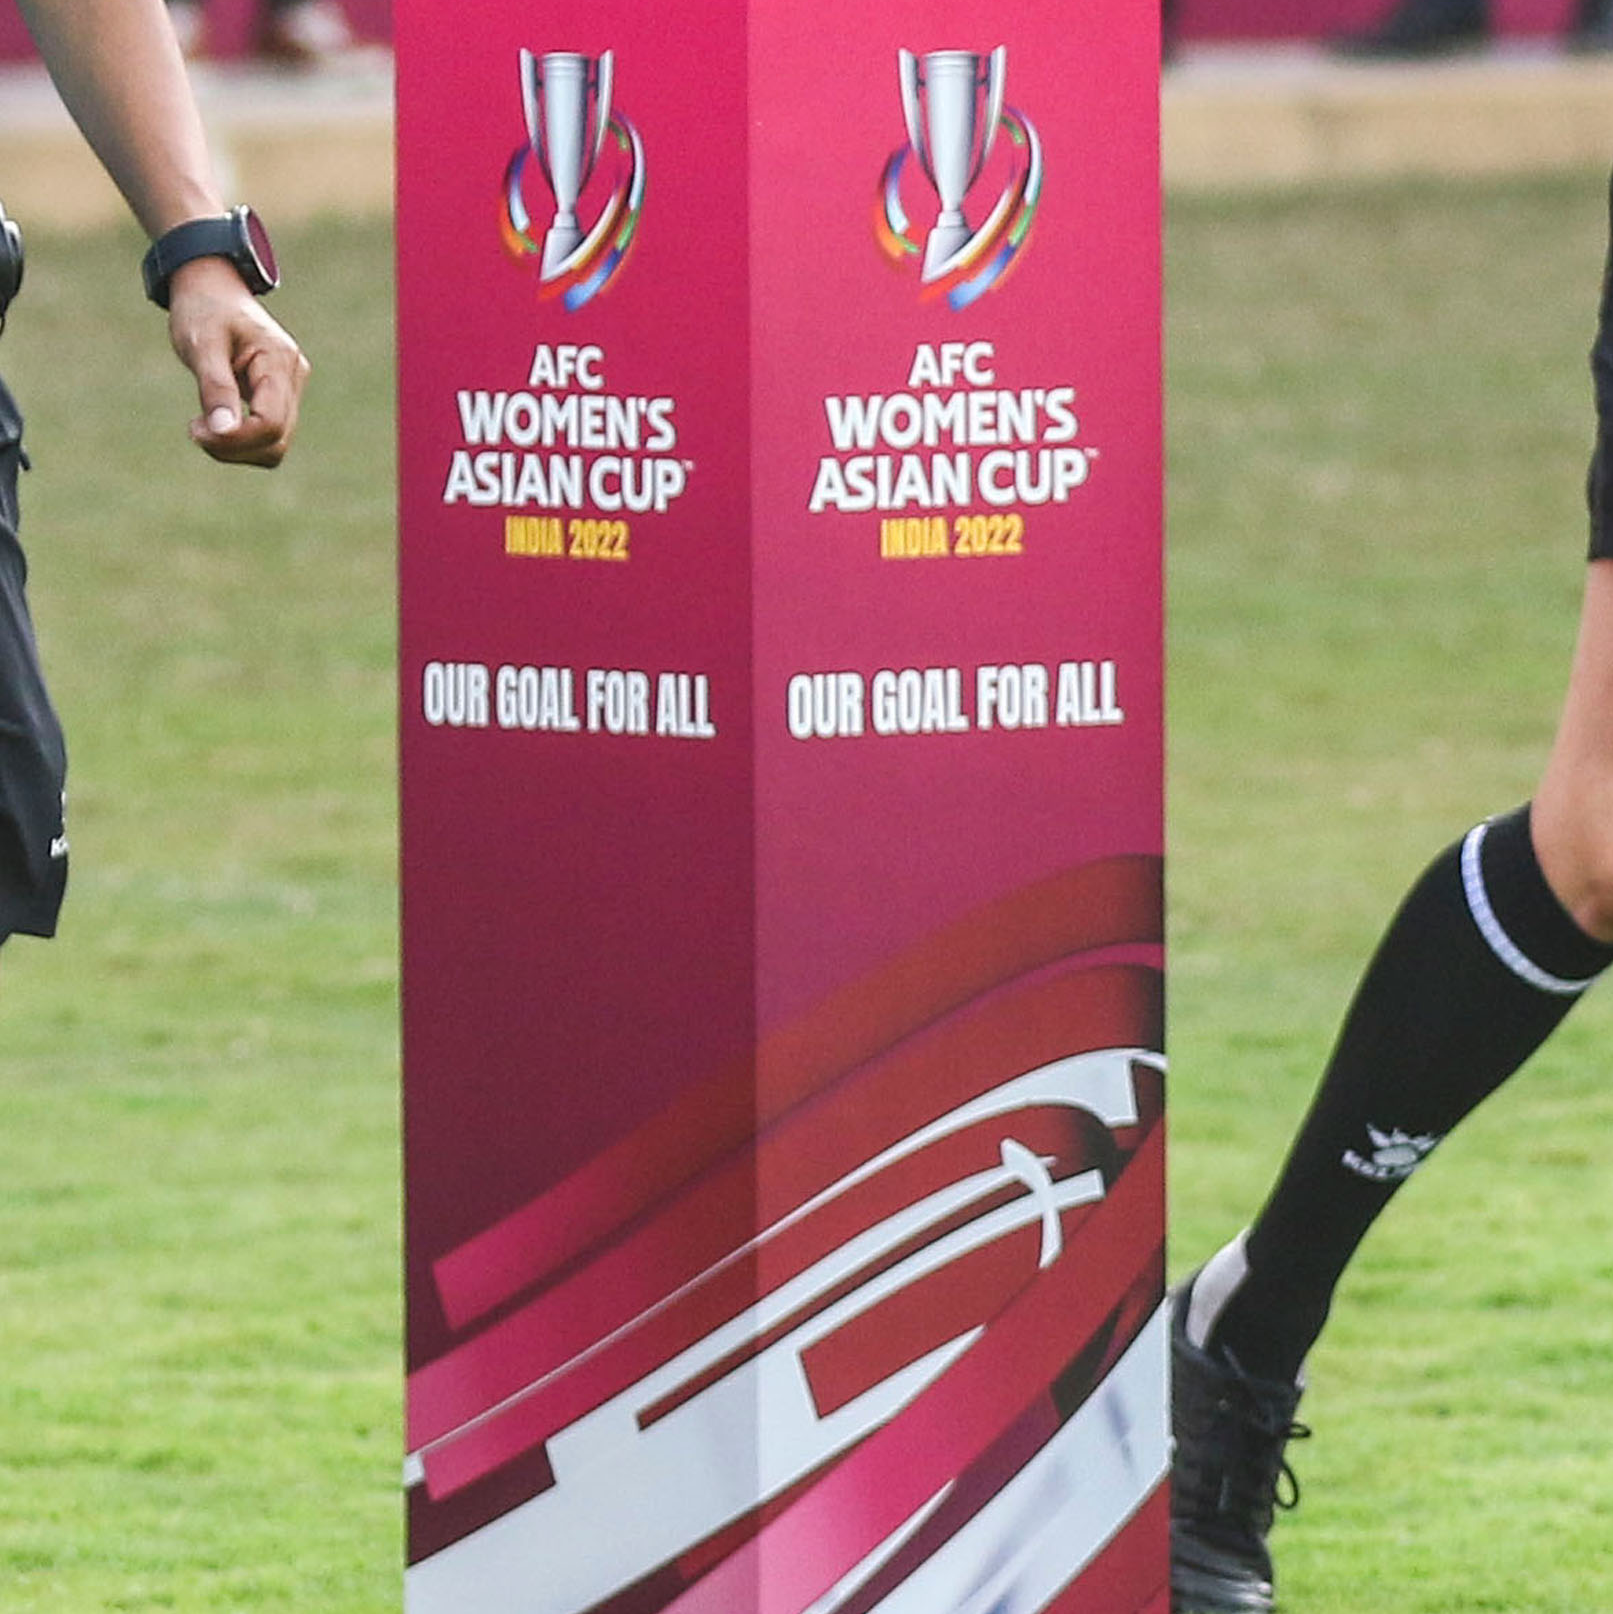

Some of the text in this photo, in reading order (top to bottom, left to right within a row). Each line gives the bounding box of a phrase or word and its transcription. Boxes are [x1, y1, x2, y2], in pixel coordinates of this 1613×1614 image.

[528, 343, 605, 390] AFC
[908, 340, 996, 388] AFC
[456, 389, 678, 453] WOMEN'S
[824, 386, 1079, 452] WOMEN'S
[442, 449, 584, 510] ASIAN
[807, 451, 973, 514] ASIAN
[505, 515, 631, 562] INDIA 2022
[881, 513, 1025, 560] INDIA 2022
[423, 661, 717, 739] OUR GOAL FOR ALL
[788, 659, 1125, 741] OUR GOAL FOR ALL
